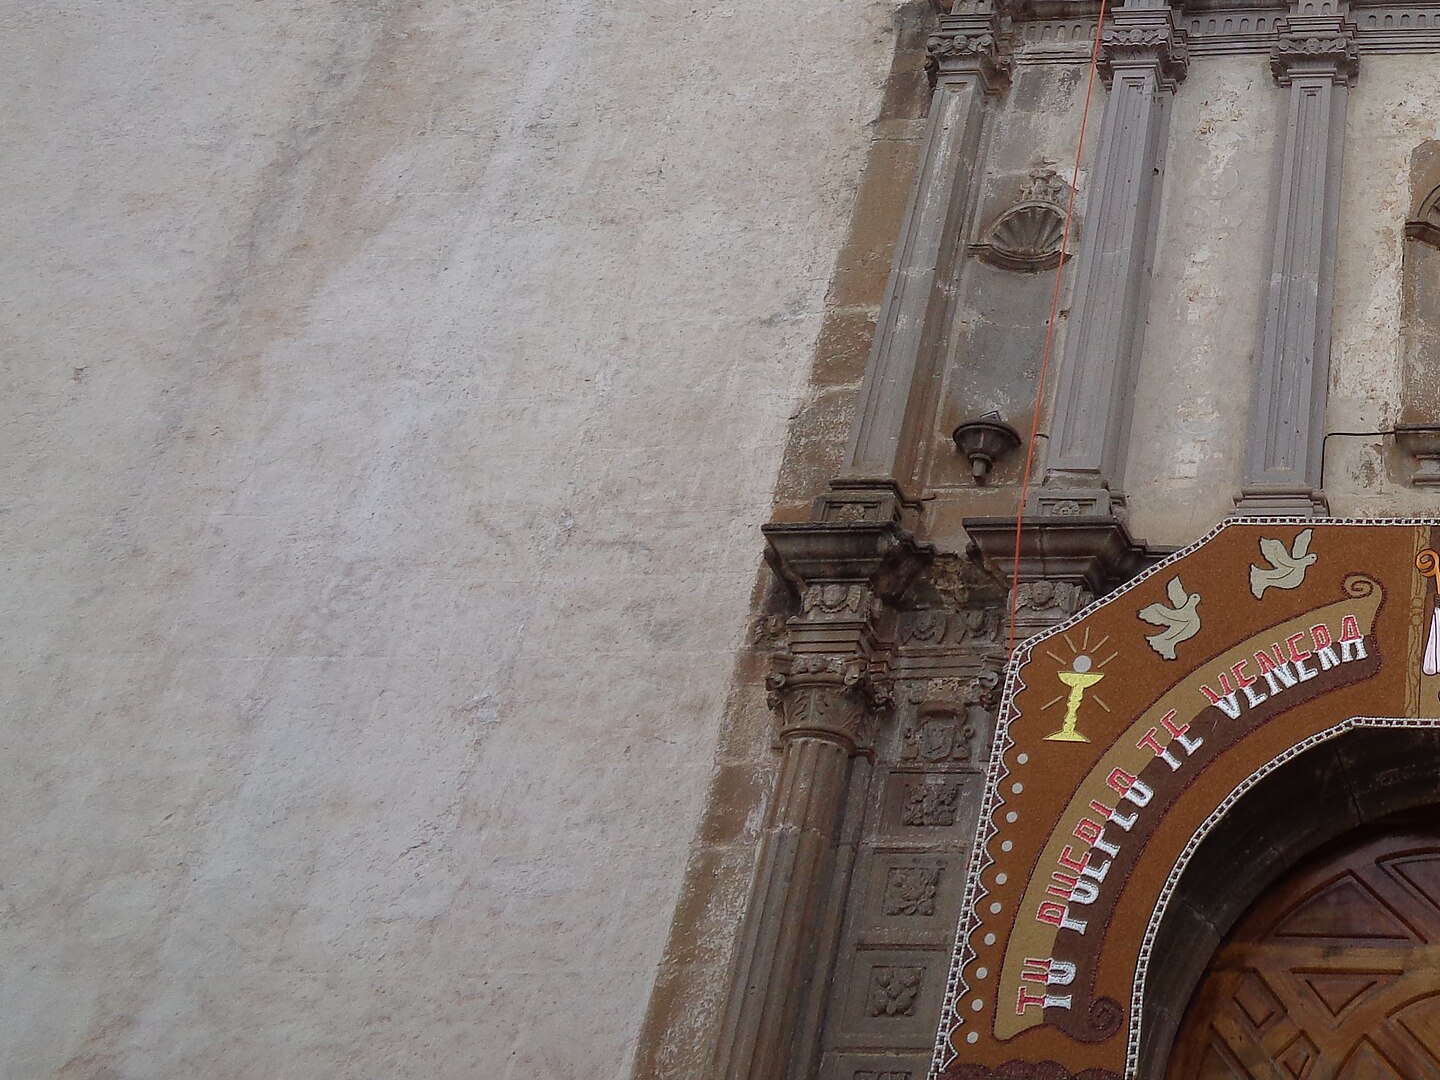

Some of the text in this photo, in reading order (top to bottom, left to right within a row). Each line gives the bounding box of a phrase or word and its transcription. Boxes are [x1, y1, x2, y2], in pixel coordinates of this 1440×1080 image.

[1016, 958, 1077, 1015] TU
[1136, 709, 1204, 772] TE
[1199, 614, 1368, 720] VENERA
